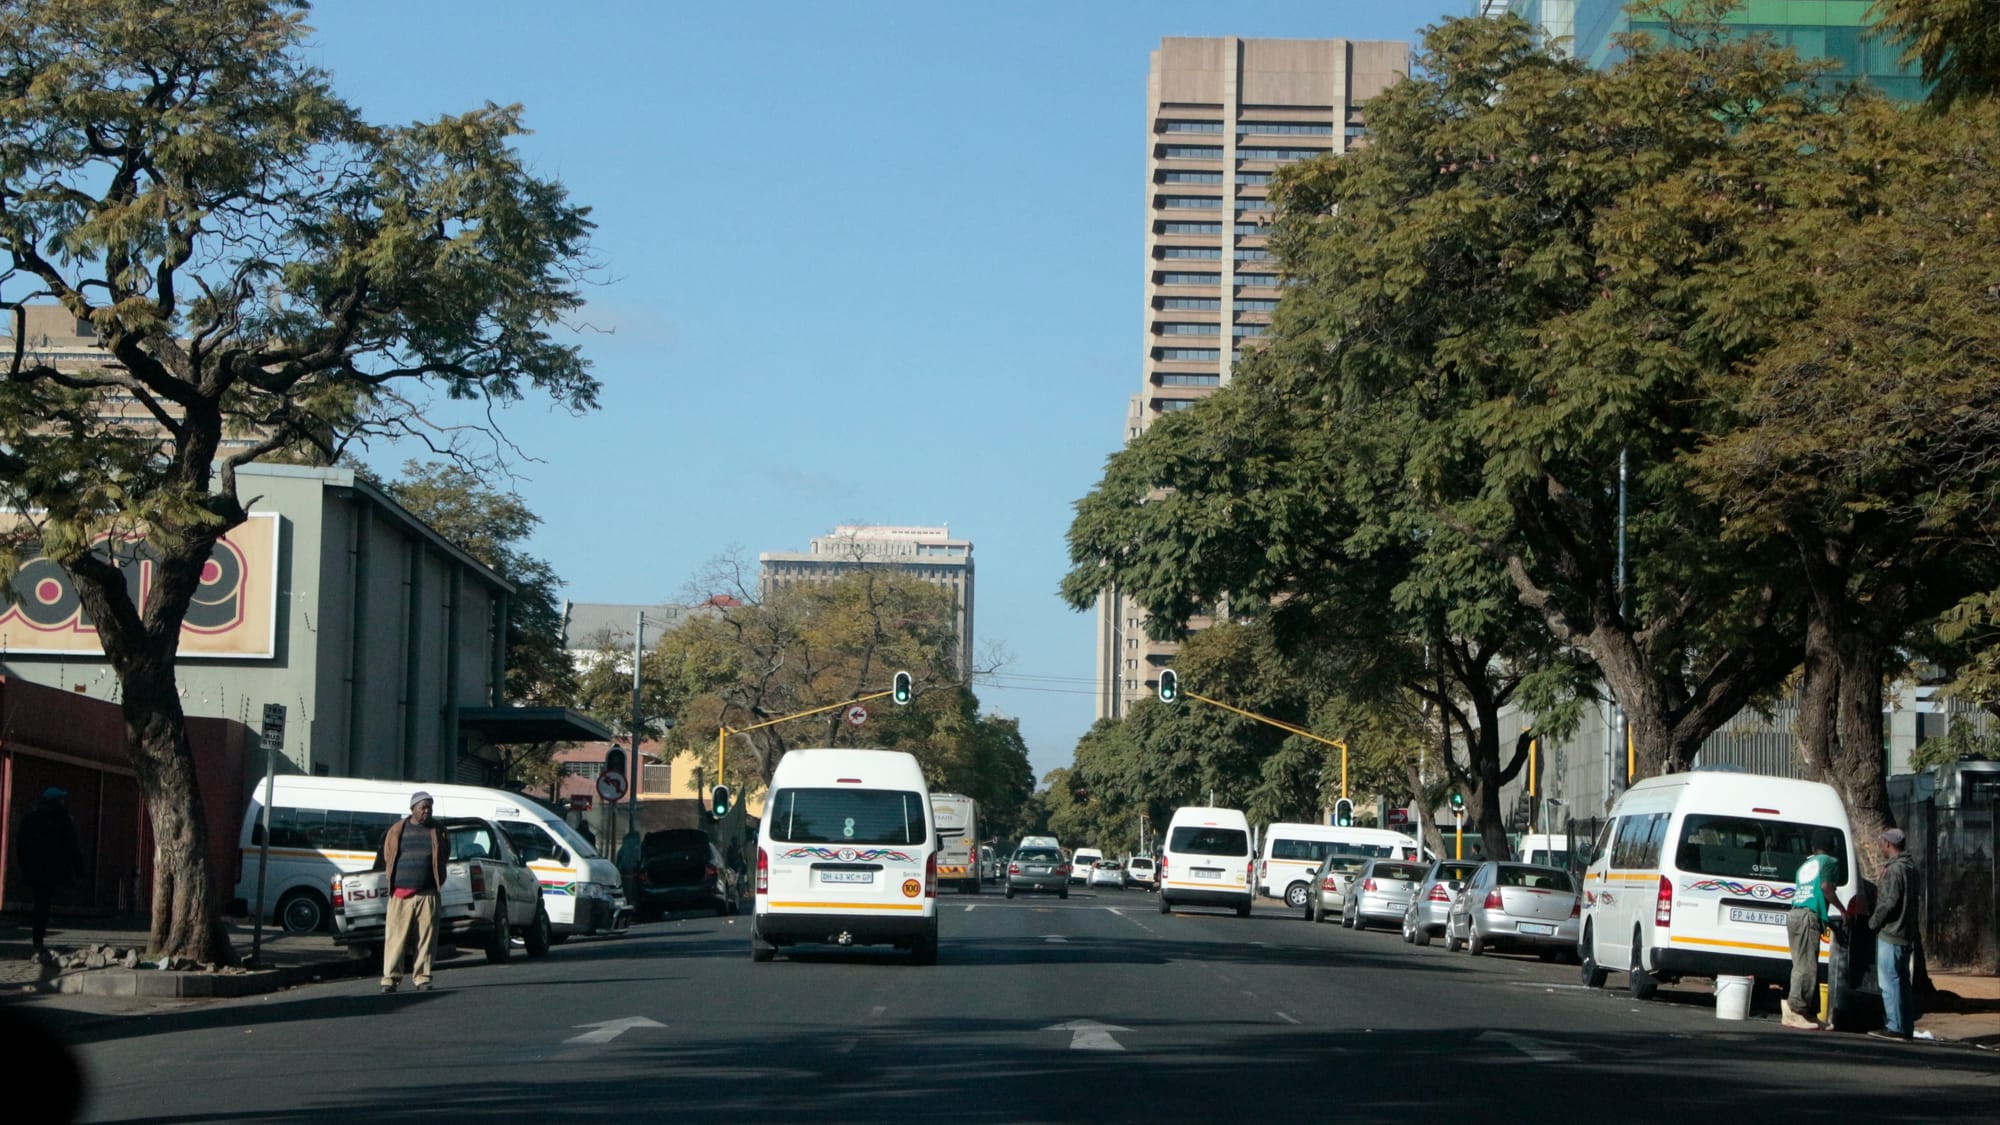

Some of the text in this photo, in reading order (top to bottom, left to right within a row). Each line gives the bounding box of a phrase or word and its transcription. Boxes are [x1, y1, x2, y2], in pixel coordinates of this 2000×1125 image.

[264, 733, 281, 741] BUS
[905, 884, 919, 893] 100
[348, 888, 389, 902] ISUZ
[1733, 910, 1785, 924] FP 46 KY GP
